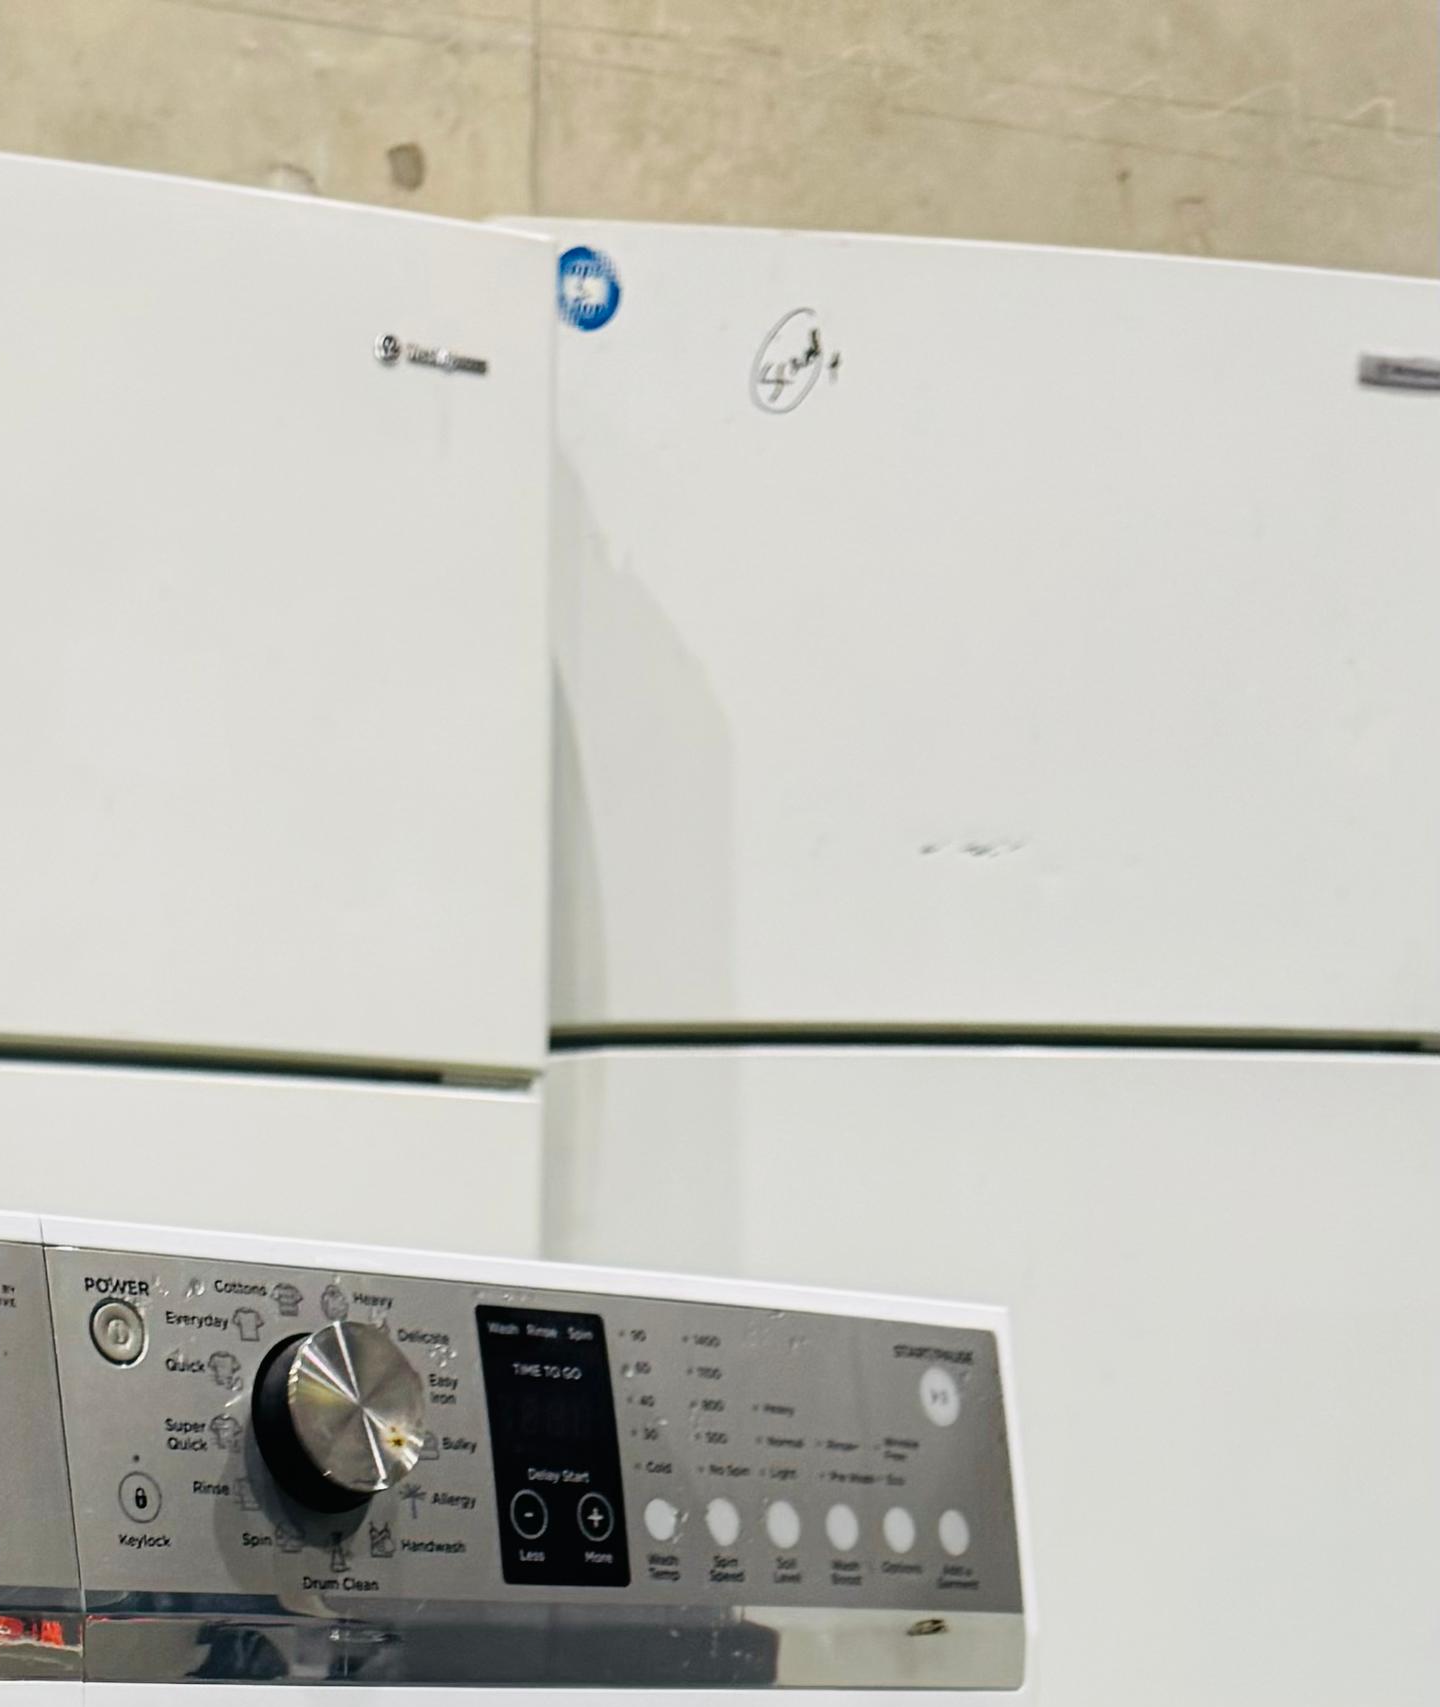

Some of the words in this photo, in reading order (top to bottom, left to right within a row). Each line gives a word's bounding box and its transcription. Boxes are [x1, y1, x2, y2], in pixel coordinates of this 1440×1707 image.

[84, 1276, 150, 1296] POWER
[214, 1279, 268, 1297] Cottons
[165, 1310, 229, 1331] Everyday
[398, 1328, 450, 1345] Delicate
[165, 1357, 206, 1373] Quick
[512, 1362, 543, 1378] TIME
[562, 1367, 582, 1380] GO
[428, 1373, 458, 1391] Easy
[164, 1418, 206, 1434] Super
[166, 1436, 209, 1452] Quick
[442, 1436, 478, 1455] Bulky
[527, 1467, 560, 1485] Delay
[646, 1461, 673, 1475] Cold
[192, 1480, 230, 1496] Rinse
[431, 1492, 477, 1510] Allergy
[117, 1533, 172, 1549] Keylock
[241, 1532, 273, 1547] Spin
[400, 1539, 467, 1554] Handwash
[303, 1576, 340, 1590] Drum
[342, 1577, 379, 1591] Clean
